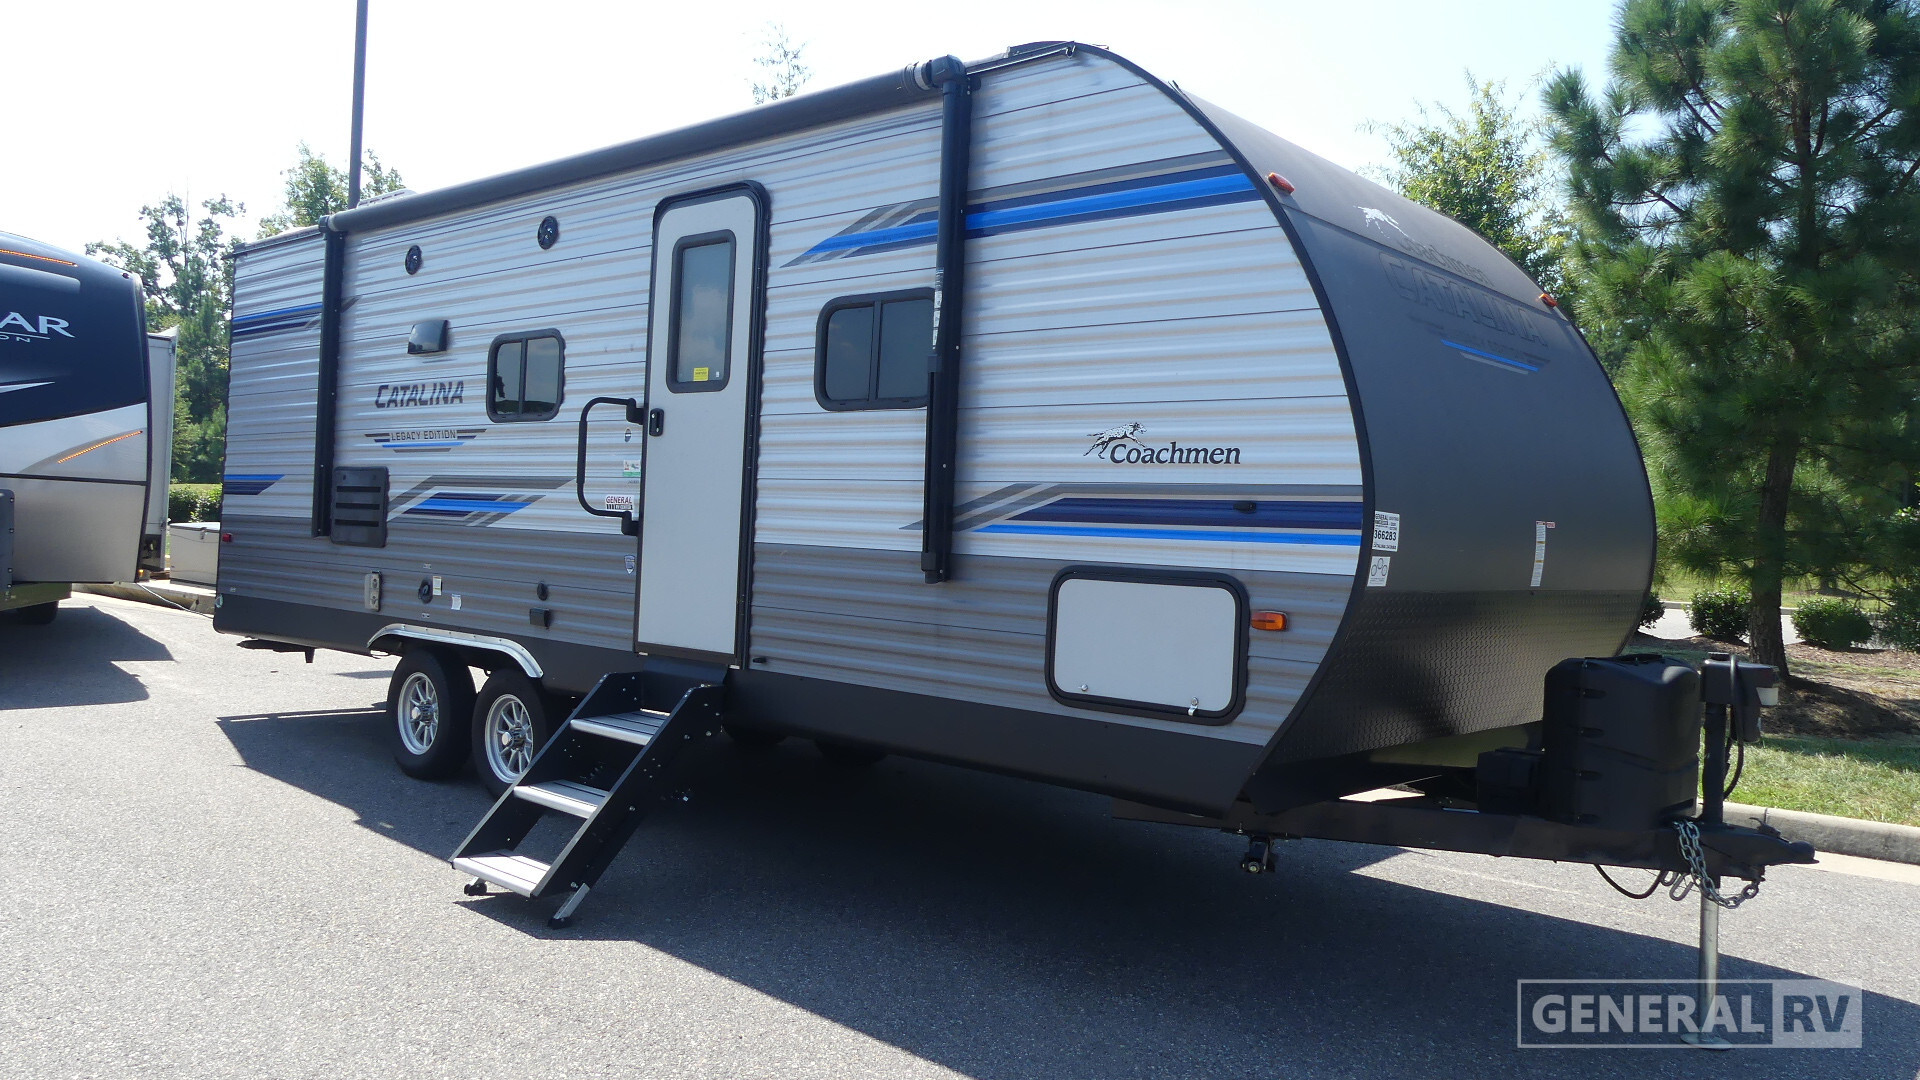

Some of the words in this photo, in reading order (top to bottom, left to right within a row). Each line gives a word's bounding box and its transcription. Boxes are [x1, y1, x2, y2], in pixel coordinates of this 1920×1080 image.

[374, 380, 464, 409] CATALINA
[391, 430, 421, 441] LEGACY
[424, 429, 457, 440] EDITION
[1109, 441, 1241, 465] Coachmen
[605, 495, 633, 504] GENERAL
[1374, 529, 1397, 541] 366283
